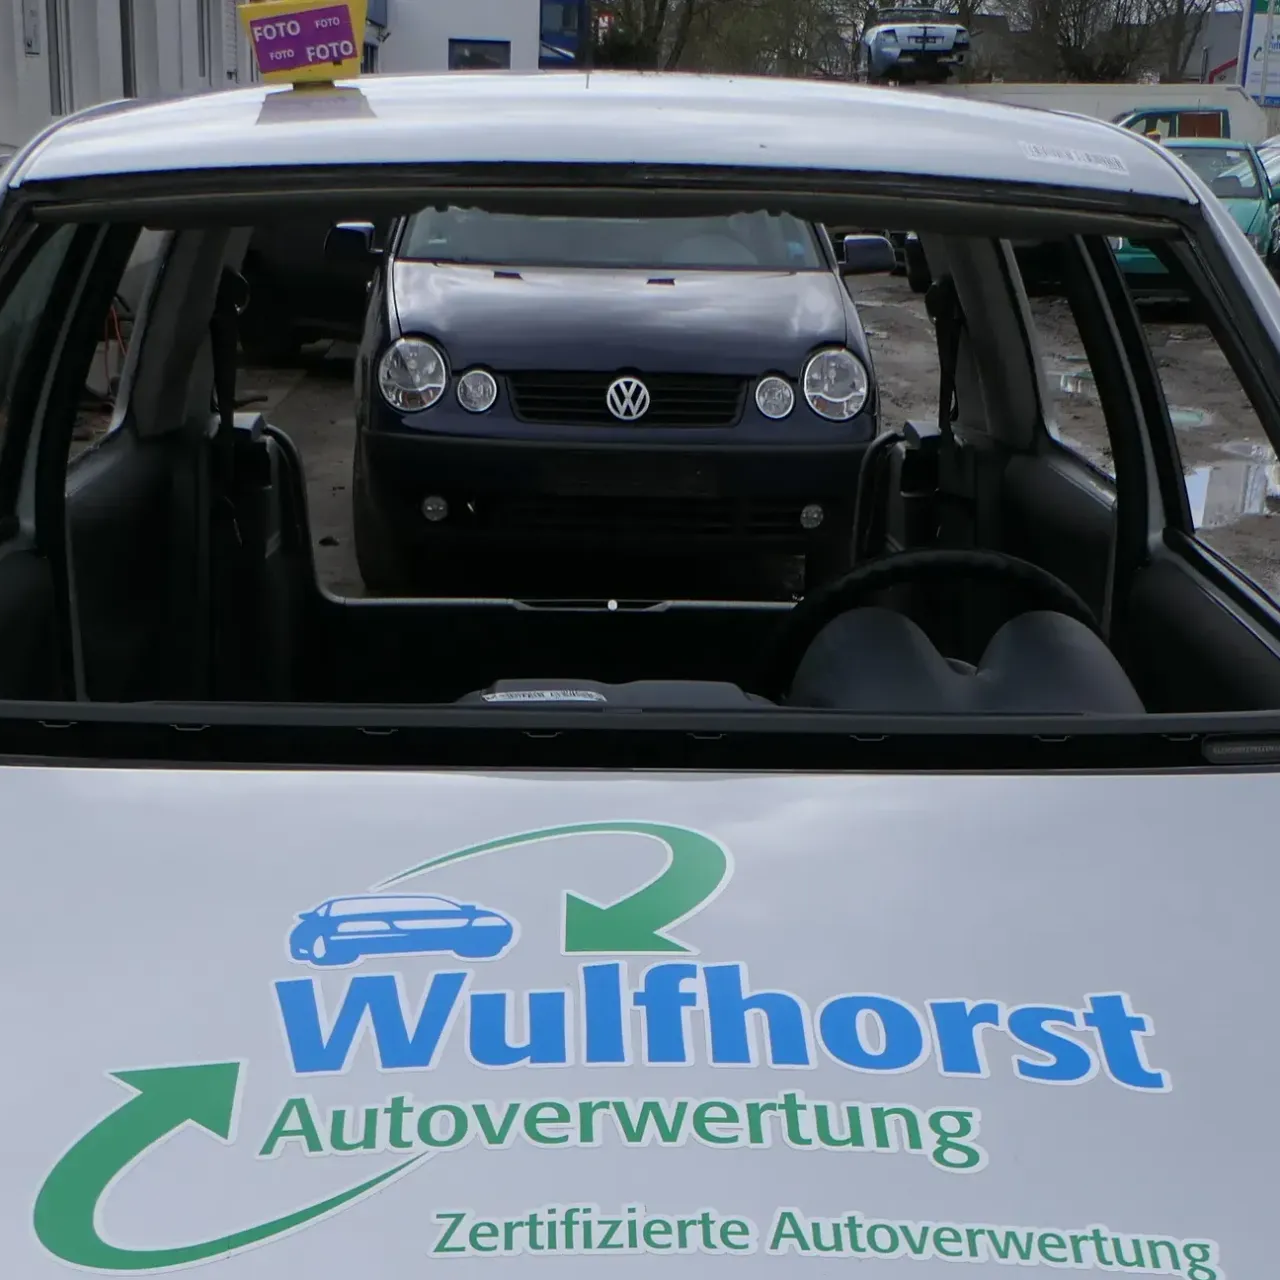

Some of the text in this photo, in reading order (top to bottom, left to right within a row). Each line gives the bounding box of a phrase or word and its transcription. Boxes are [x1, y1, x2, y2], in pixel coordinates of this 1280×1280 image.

[253, 17, 340, 42] FOTO FOTO
[269, 41, 354, 62] FOTO FOTO
[607, 378, 650, 420] VW
[274, 961, 1167, 1090] Wulfhorst
[260, 1093, 982, 1169] Autoverwertung
[435, 1207, 750, 1253] Zertifizierte
